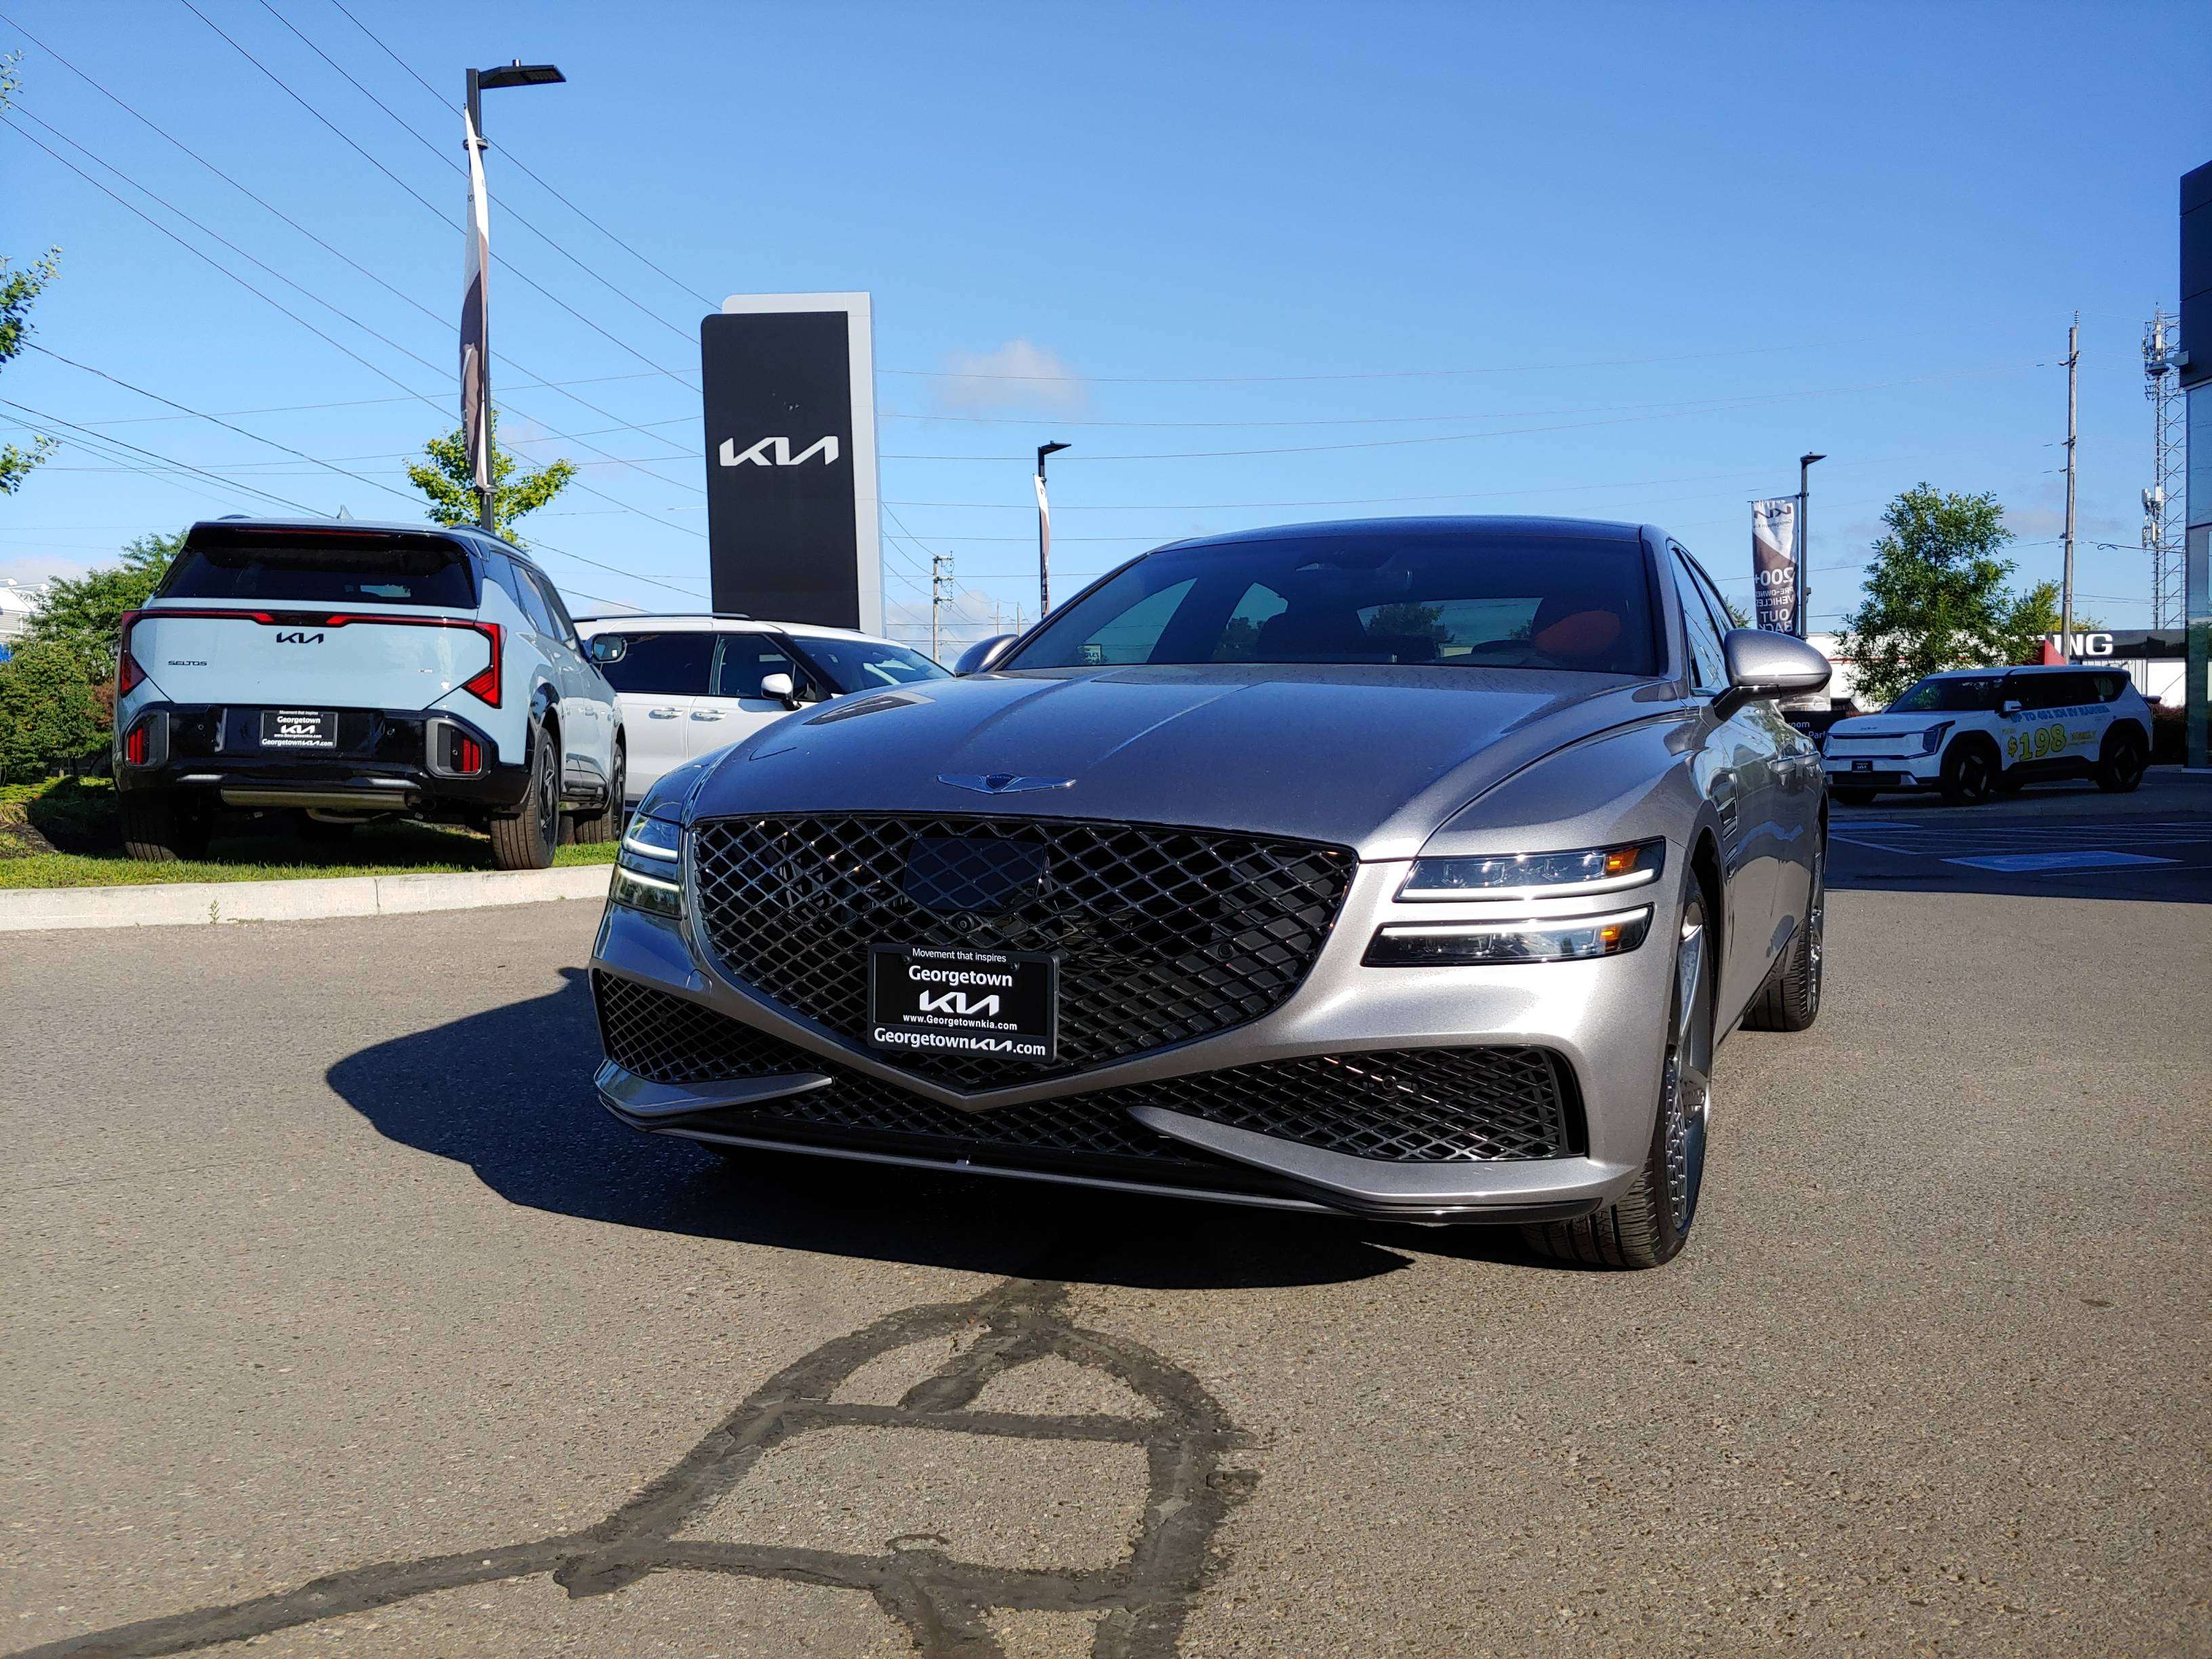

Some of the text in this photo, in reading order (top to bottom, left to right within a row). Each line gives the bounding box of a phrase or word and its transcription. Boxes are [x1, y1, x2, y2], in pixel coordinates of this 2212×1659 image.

[719, 436, 840, 467] KIA
[276, 632, 324, 644] KIA
[281, 724, 315, 733] KIA
[2008, 723, 2067, 761] $198
[912, 948, 1007, 963] Movement that inspires
[908, 965, 1013, 987] Georgetown
[919, 989, 1000, 1017] KIA
[903, 1015, 1018, 1031] www.Georgetownkia.com
